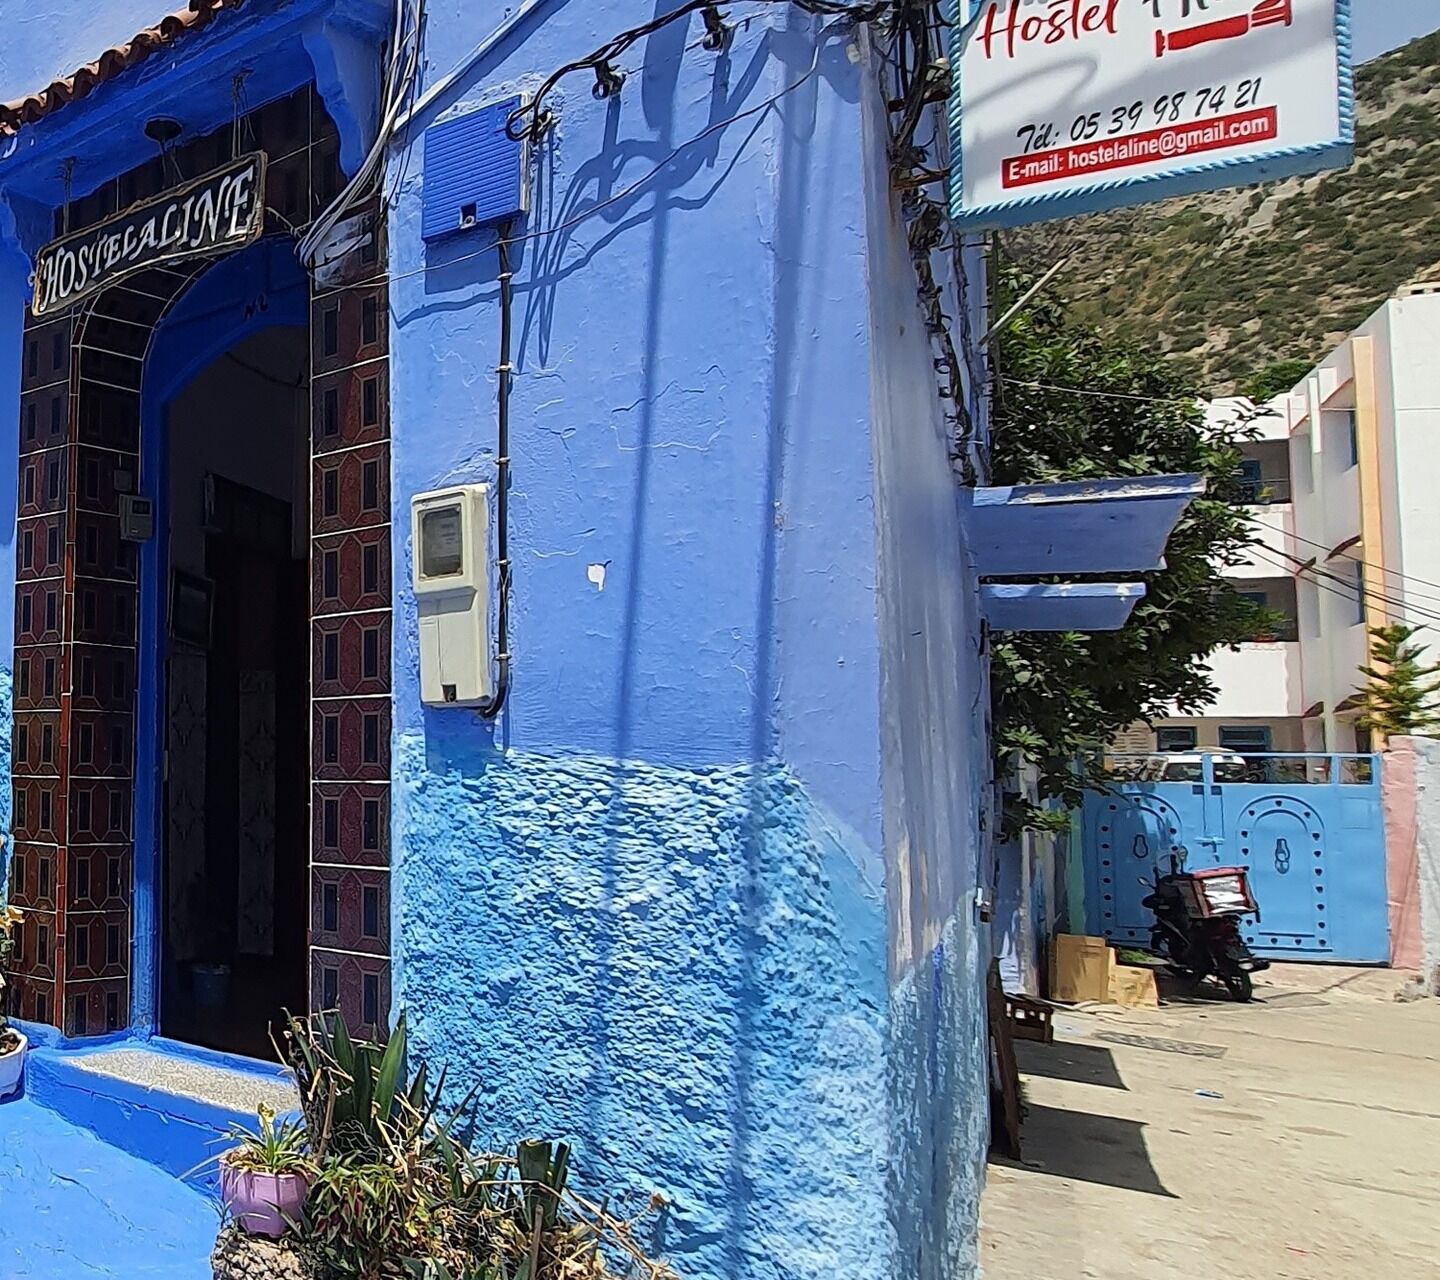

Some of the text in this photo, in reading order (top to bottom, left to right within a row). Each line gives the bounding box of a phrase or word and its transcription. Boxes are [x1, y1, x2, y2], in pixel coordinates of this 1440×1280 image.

[1008, 117, 1269, 182] E-mail: hostelaline@gmail.com
[1016, 76, 1262, 154] Tél: 05 39 98 74 21
